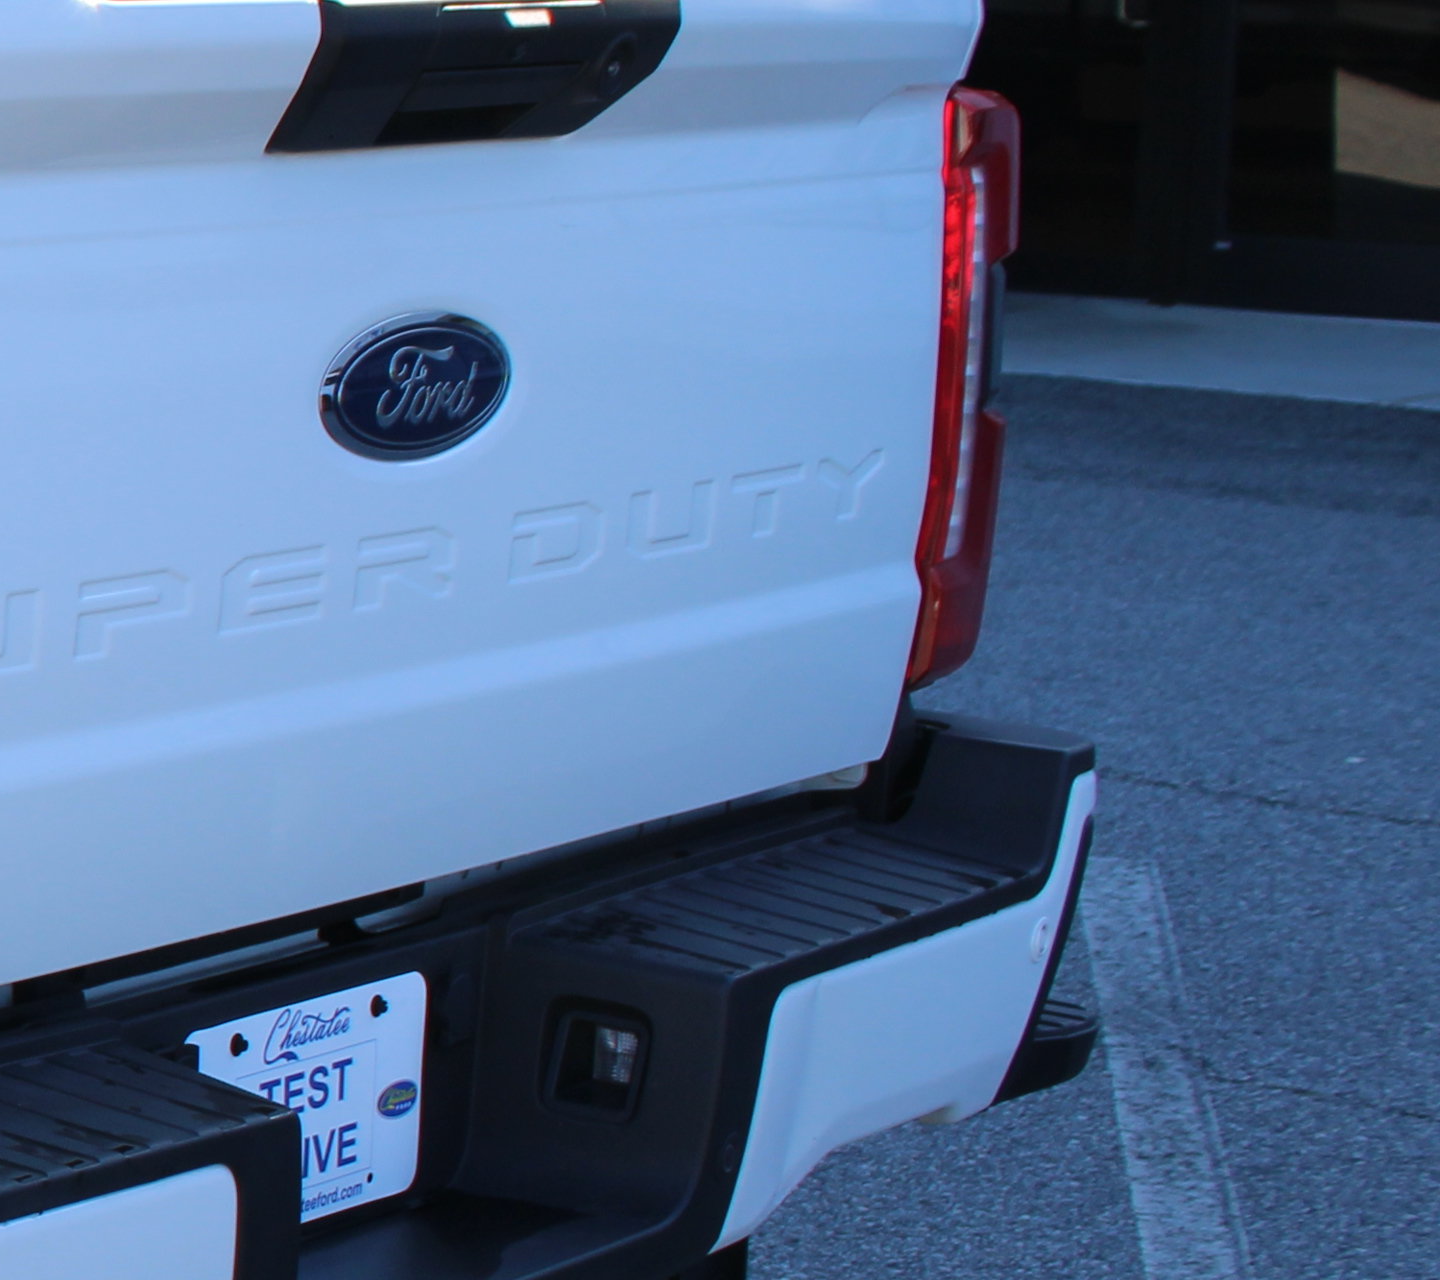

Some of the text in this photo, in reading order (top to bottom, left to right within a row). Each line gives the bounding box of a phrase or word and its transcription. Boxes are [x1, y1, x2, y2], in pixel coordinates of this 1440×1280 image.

[377, 345, 479, 426] Ford
[507, 447, 885, 584] DUTY
[264, 1008, 350, 1065] Chestatee
[302, 1121, 359, 1179] IVE
